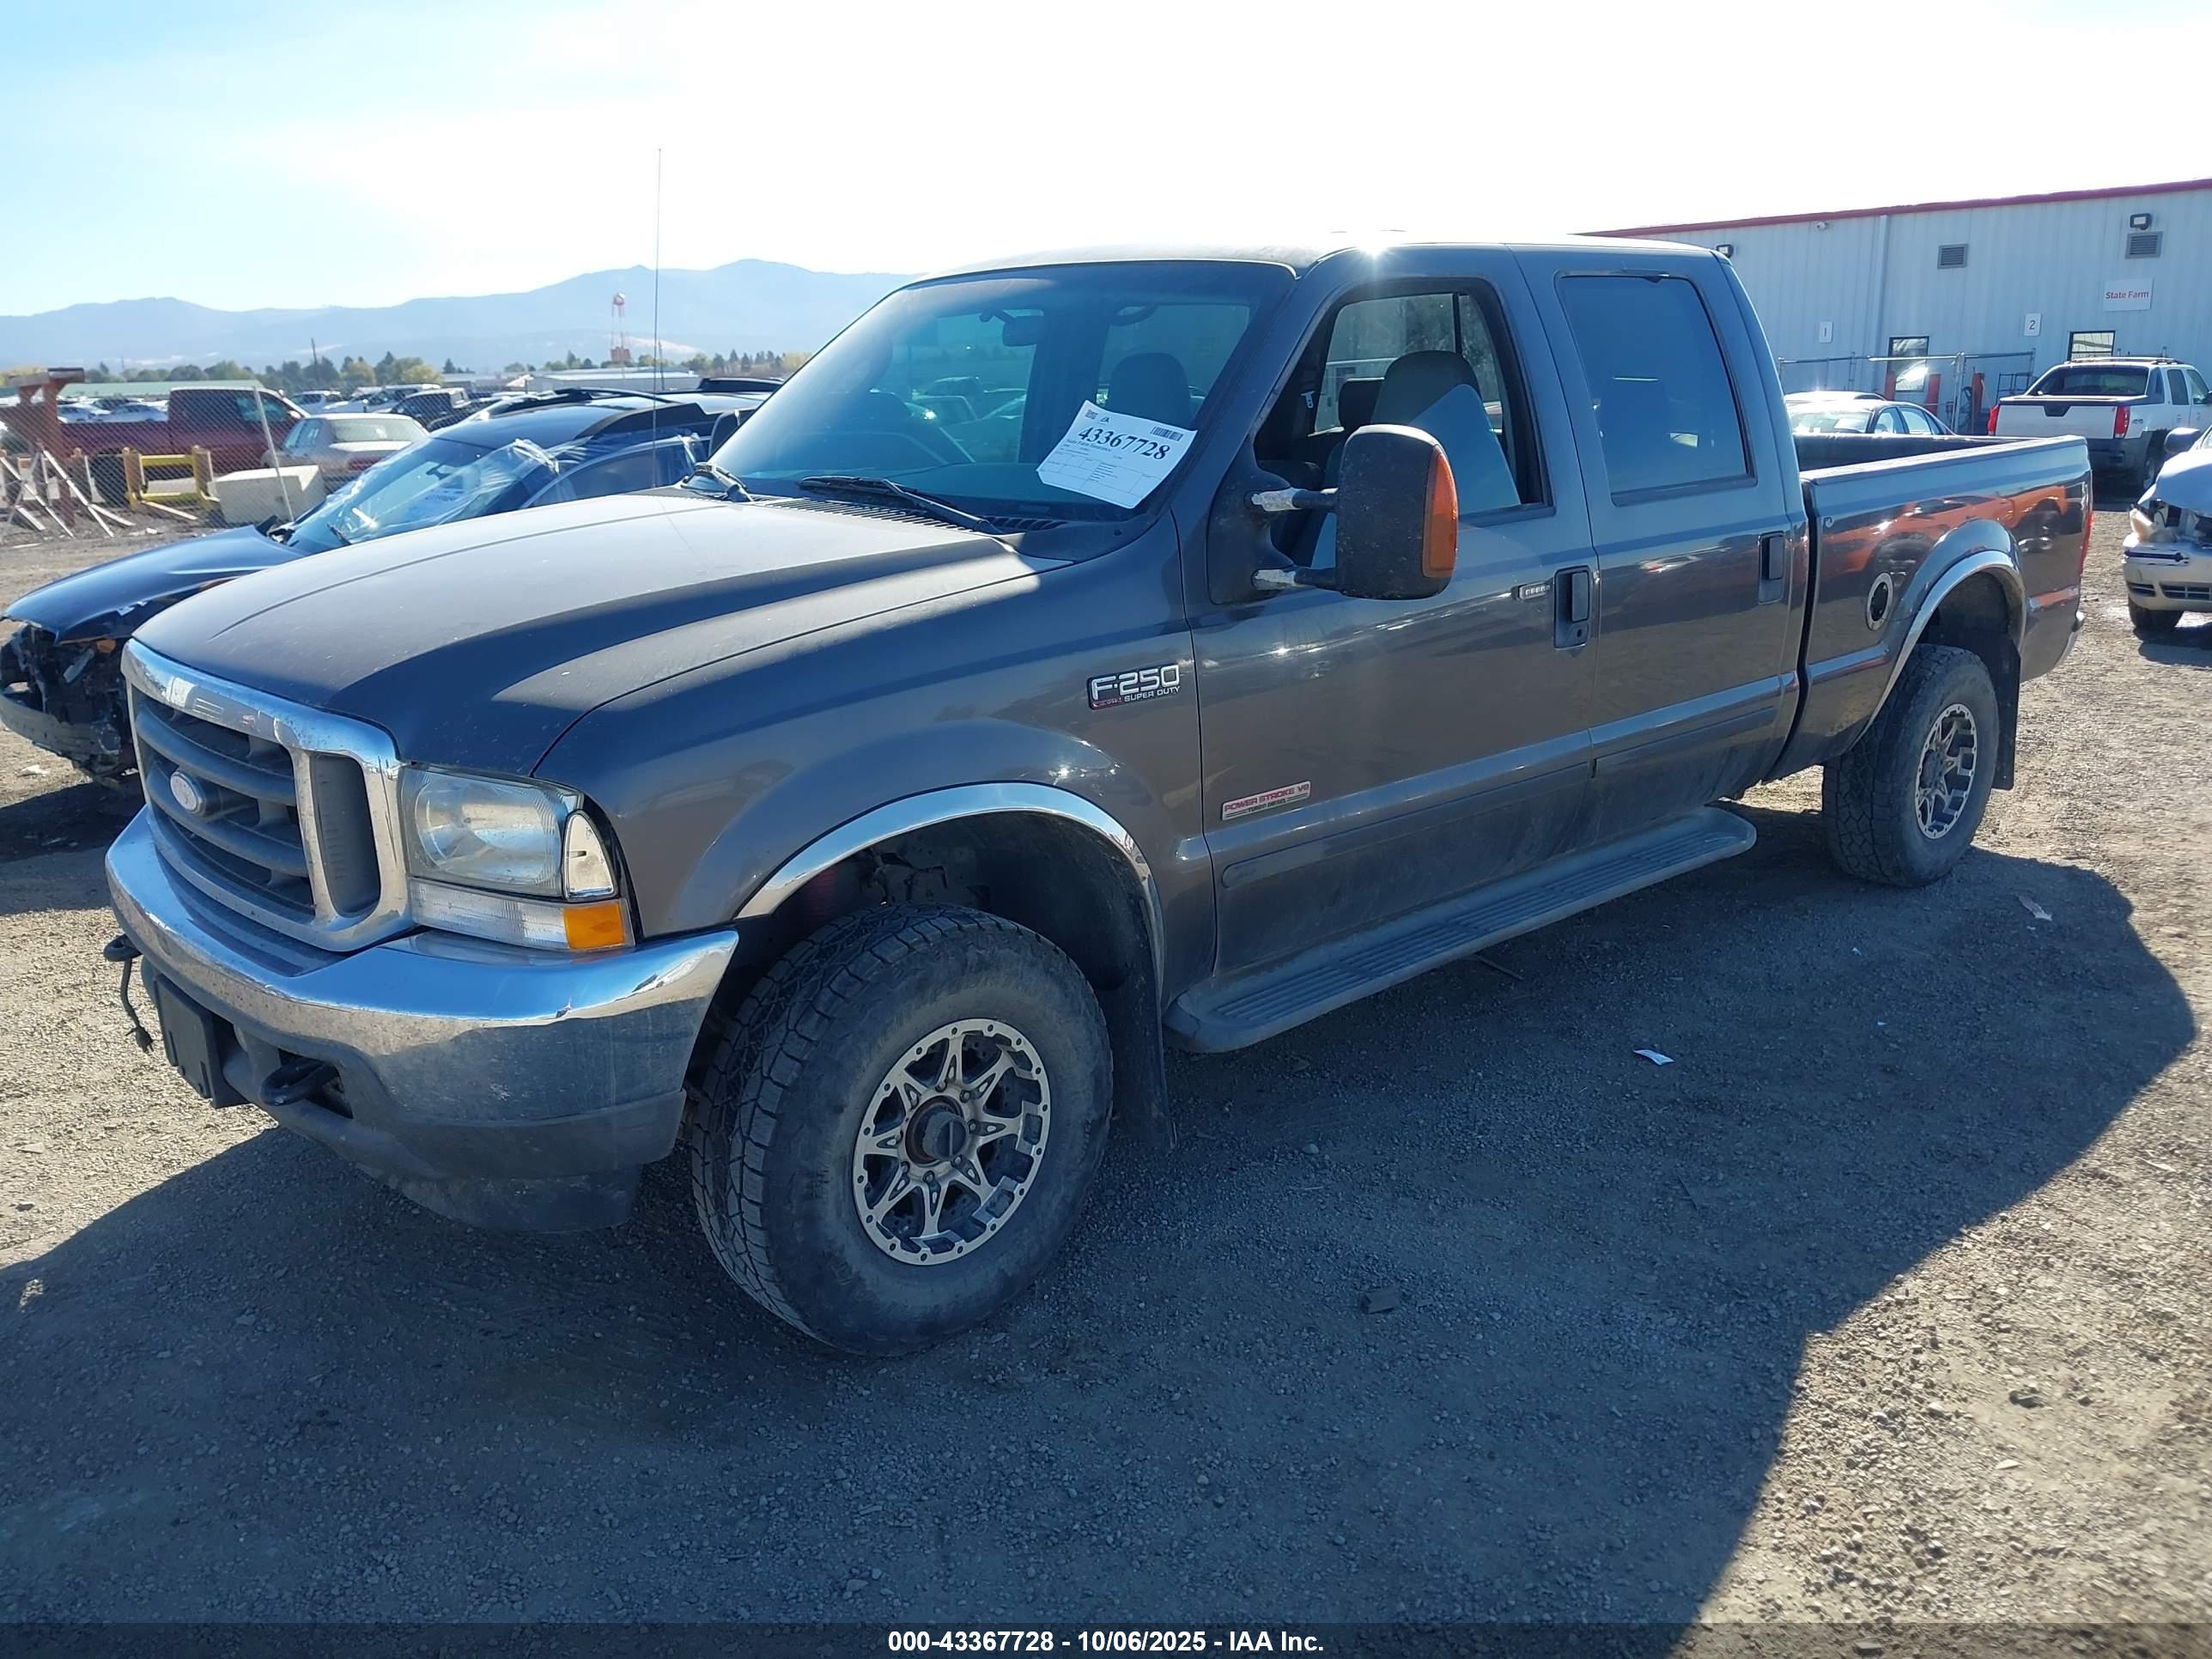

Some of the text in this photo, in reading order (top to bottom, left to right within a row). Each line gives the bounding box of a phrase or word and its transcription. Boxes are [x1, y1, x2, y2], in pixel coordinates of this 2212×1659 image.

[2106, 290, 2149, 300] State Farm
[2028, 319, 2036, 331] 2
[1078, 427, 1171, 460] 43367728
[1124, 691, 1154, 702] SUPER
[1157, 685, 1181, 696] DUTY
[1224, 797, 1258, 812] POWER
[1259, 787, 1295, 803] STROKE
